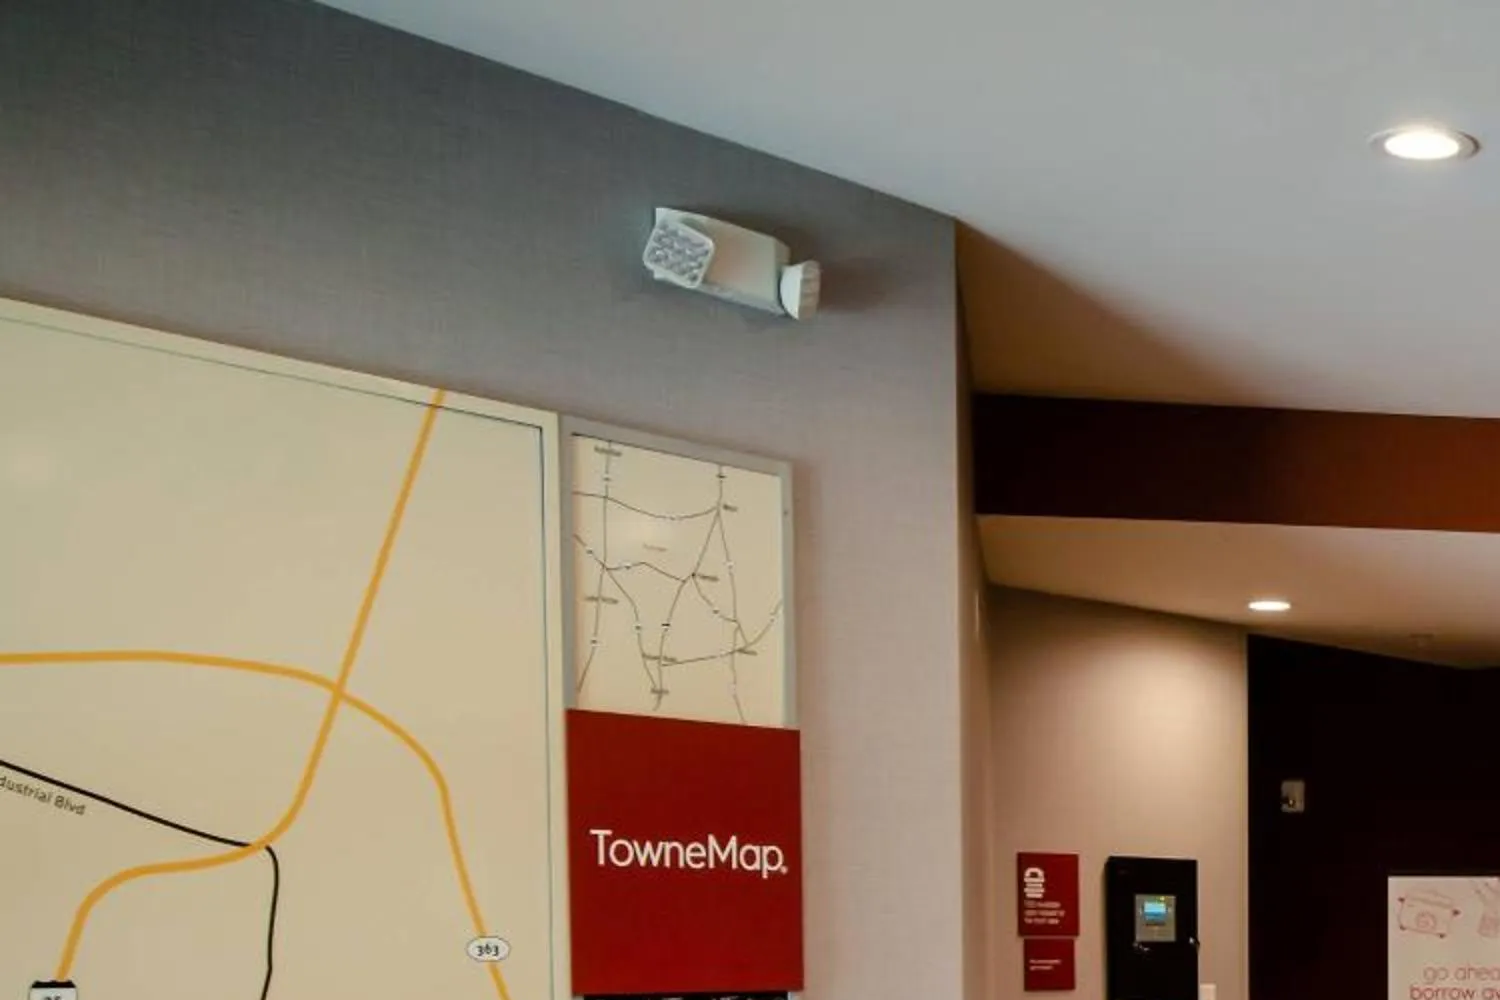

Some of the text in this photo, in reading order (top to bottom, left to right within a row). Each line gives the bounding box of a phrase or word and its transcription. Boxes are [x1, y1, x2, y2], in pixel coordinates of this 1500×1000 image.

[54, 795, 86, 815] Blvd
[477, 943, 499, 957] 363
[1423, 966, 1449, 984] go
[1409, 984, 1475, 1000] borrow
